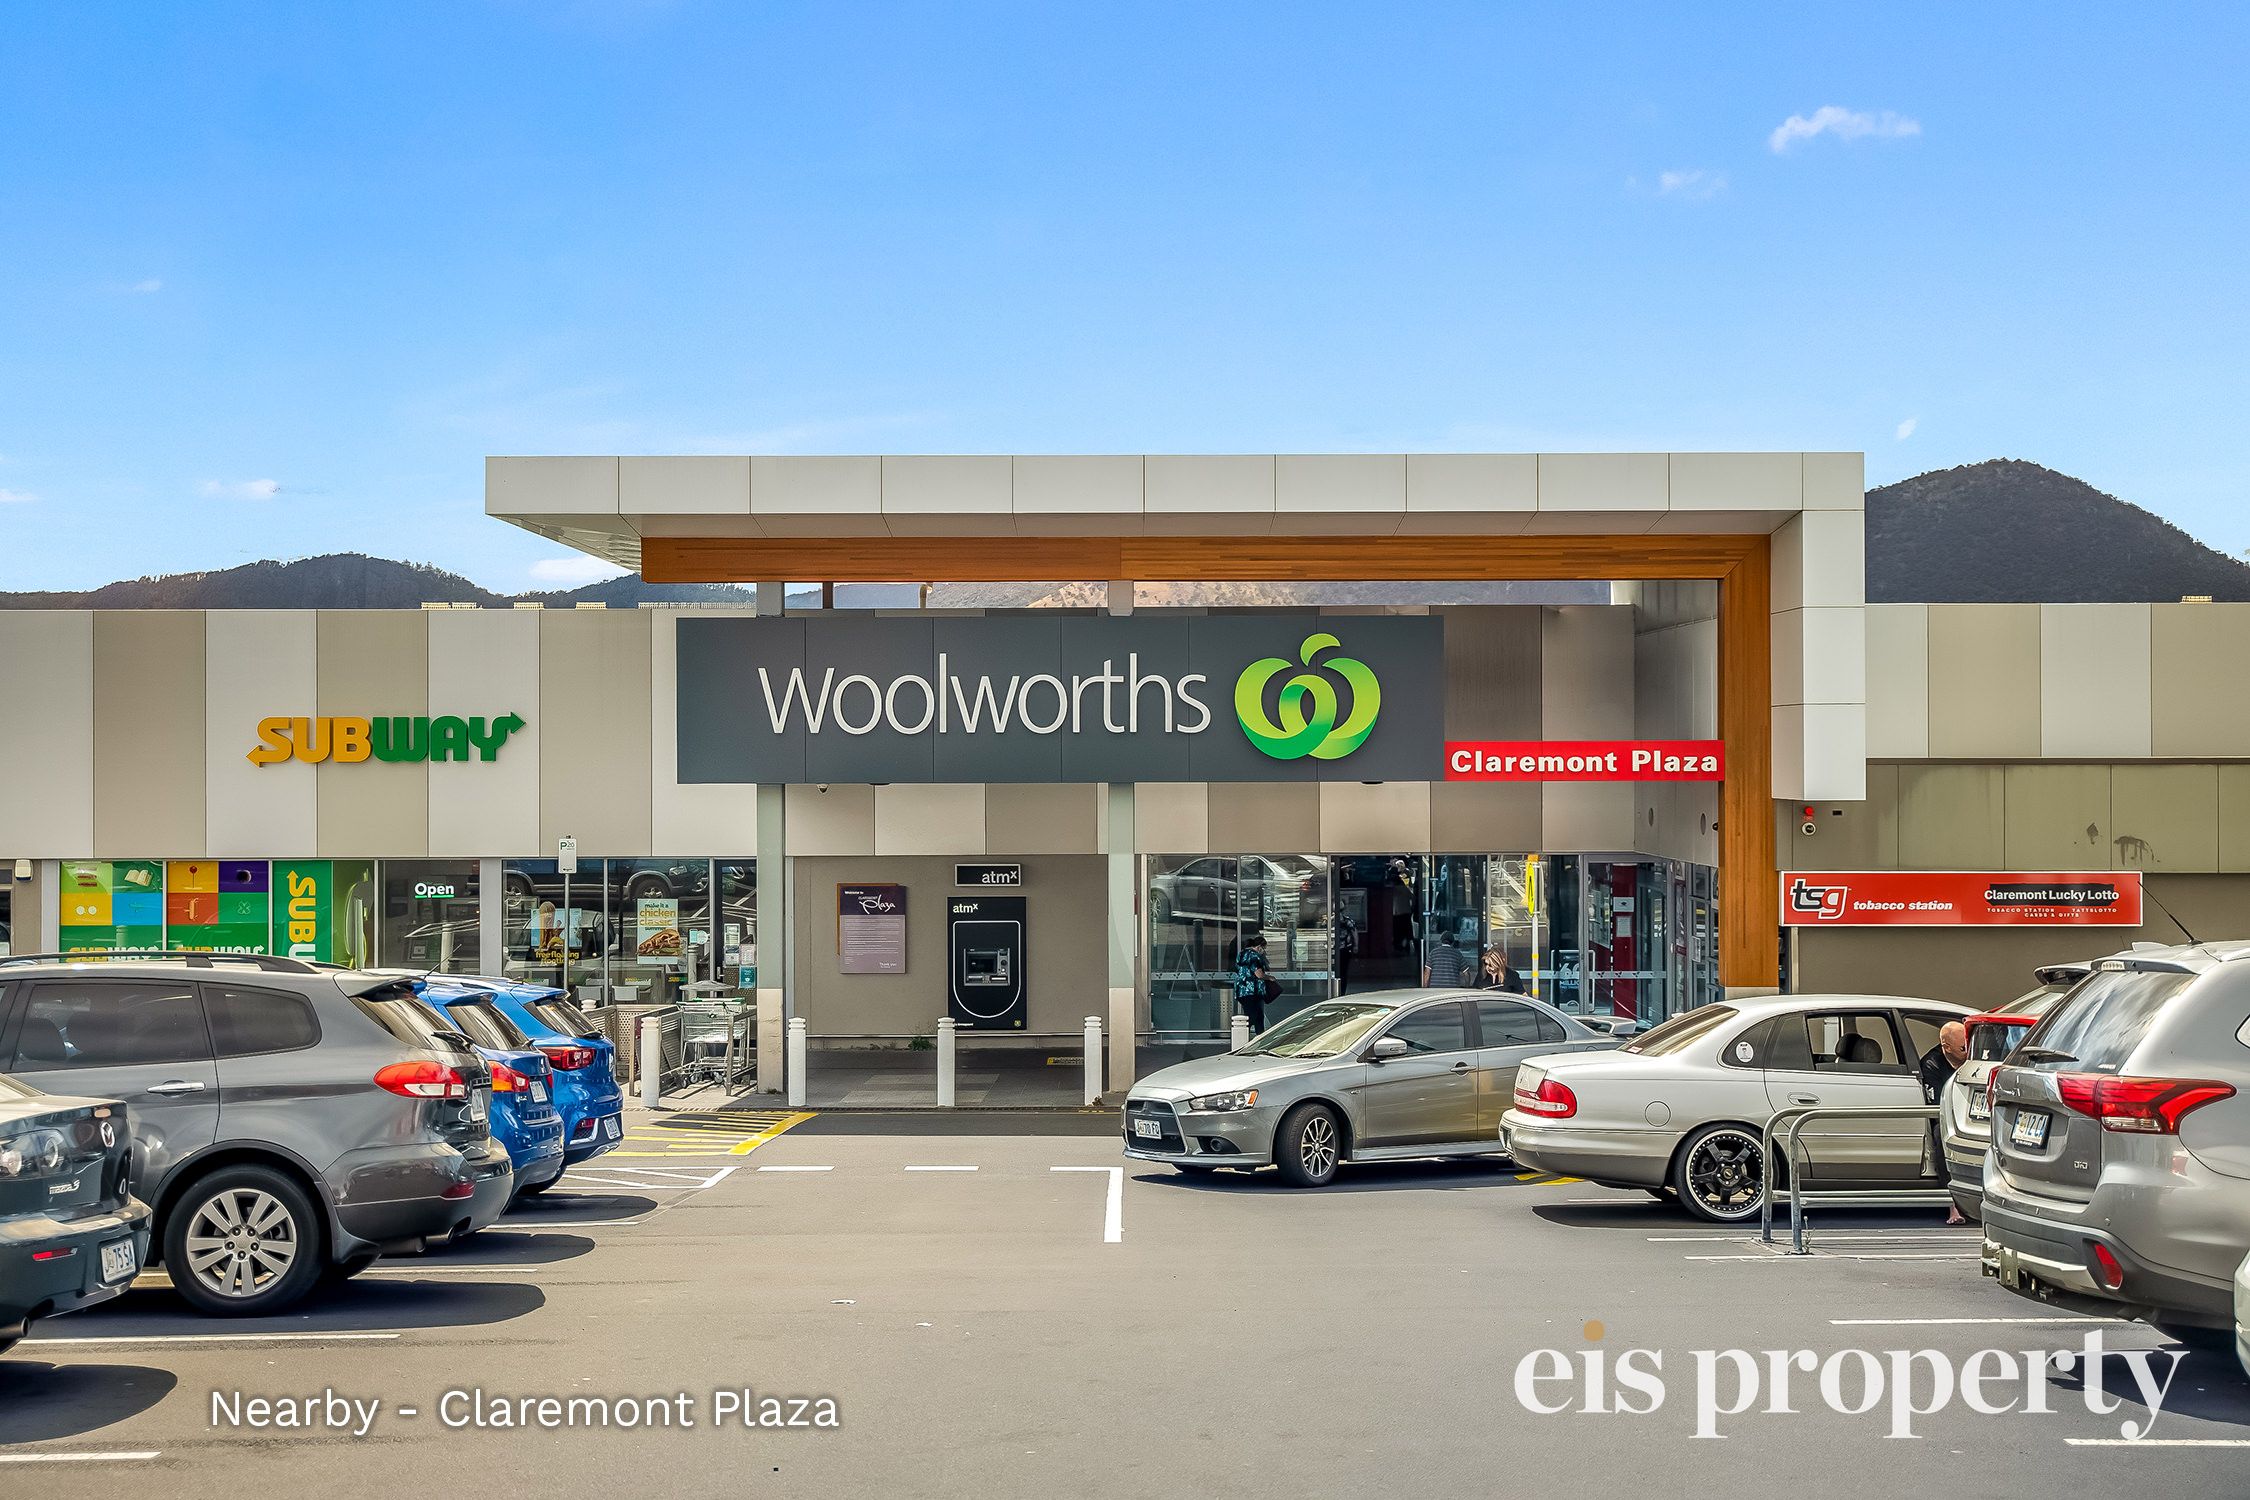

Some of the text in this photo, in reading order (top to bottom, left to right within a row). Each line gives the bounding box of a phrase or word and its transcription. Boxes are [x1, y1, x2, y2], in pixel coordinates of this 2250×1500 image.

[758, 652, 1212, 735] Woolworths
[245, 711, 527, 768] SUBWAY
[1451, 750, 1718, 773] Claremont Plaza
[981, 870, 1018, 884] atmx
[414, 882, 455, 899] Open
[1984, 889, 2120, 902] Claremont Lucky Lotto
[1790, 878, 1848, 919] tsg
[1853, 900, 1953, 911] tobacco station
[640, 908, 676, 917] chicken
[952, 903, 979, 914] atmx
[640, 917, 673, 926] classic
